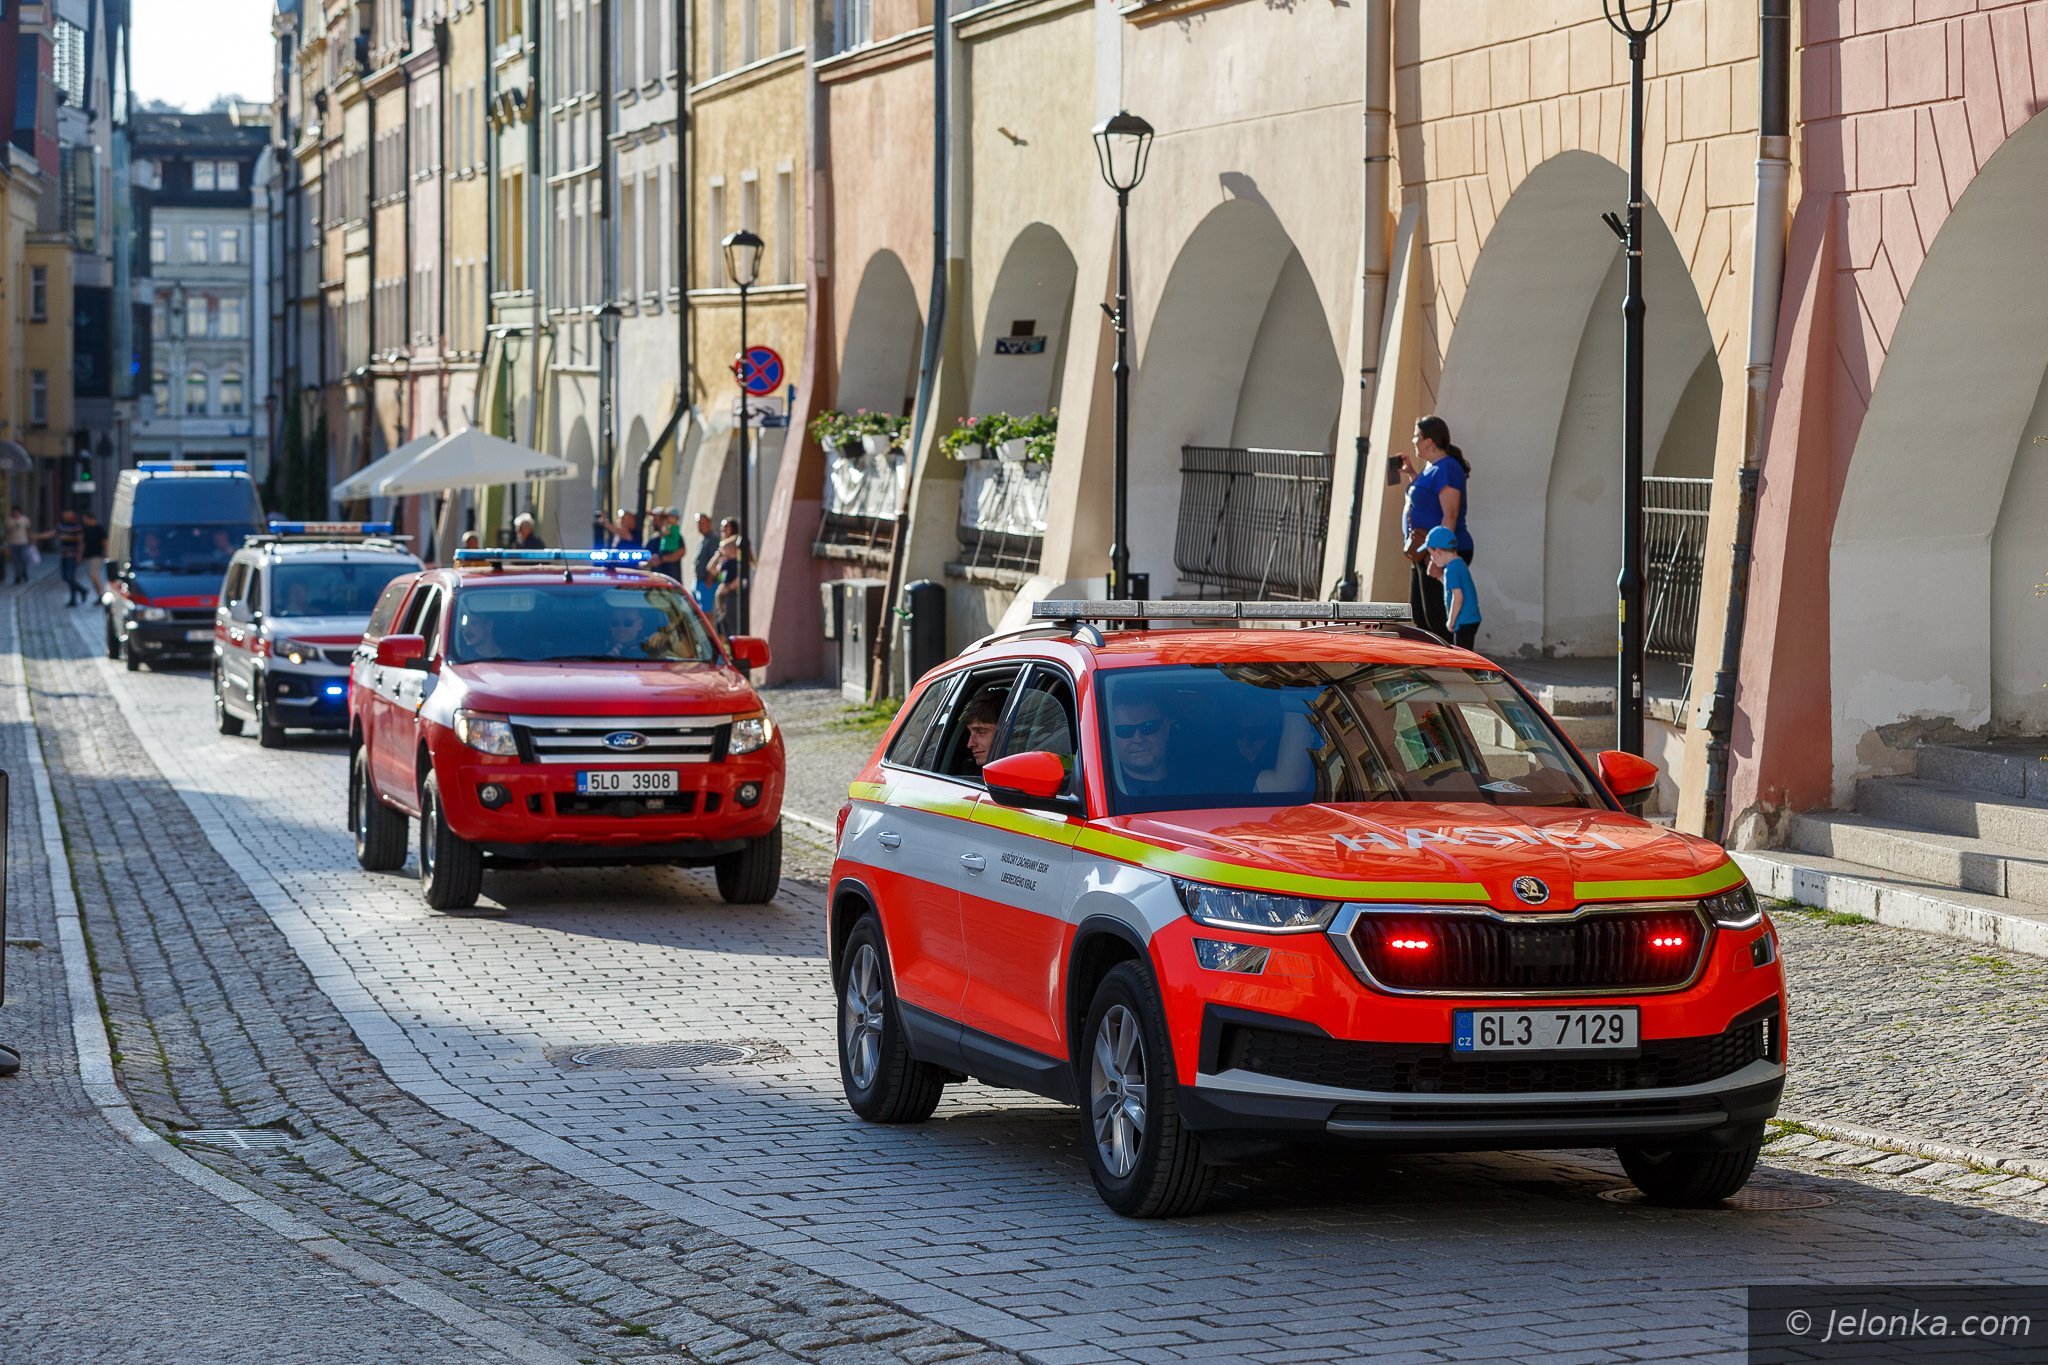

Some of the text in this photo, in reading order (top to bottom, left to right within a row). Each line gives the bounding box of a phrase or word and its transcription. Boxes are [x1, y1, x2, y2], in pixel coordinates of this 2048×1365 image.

[524, 466, 567, 478] PEPSI
[613, 734, 638, 746] Ford
[591, 773, 670, 790] 5L0 3908
[1037, 862, 1050, 874] SBOR
[1000, 872, 1037, 891] LIBERECKÉHO KRAJE
[1480, 1014, 1623, 1046] 6L3 7129
[1458, 1037, 1471, 1046] CZ
